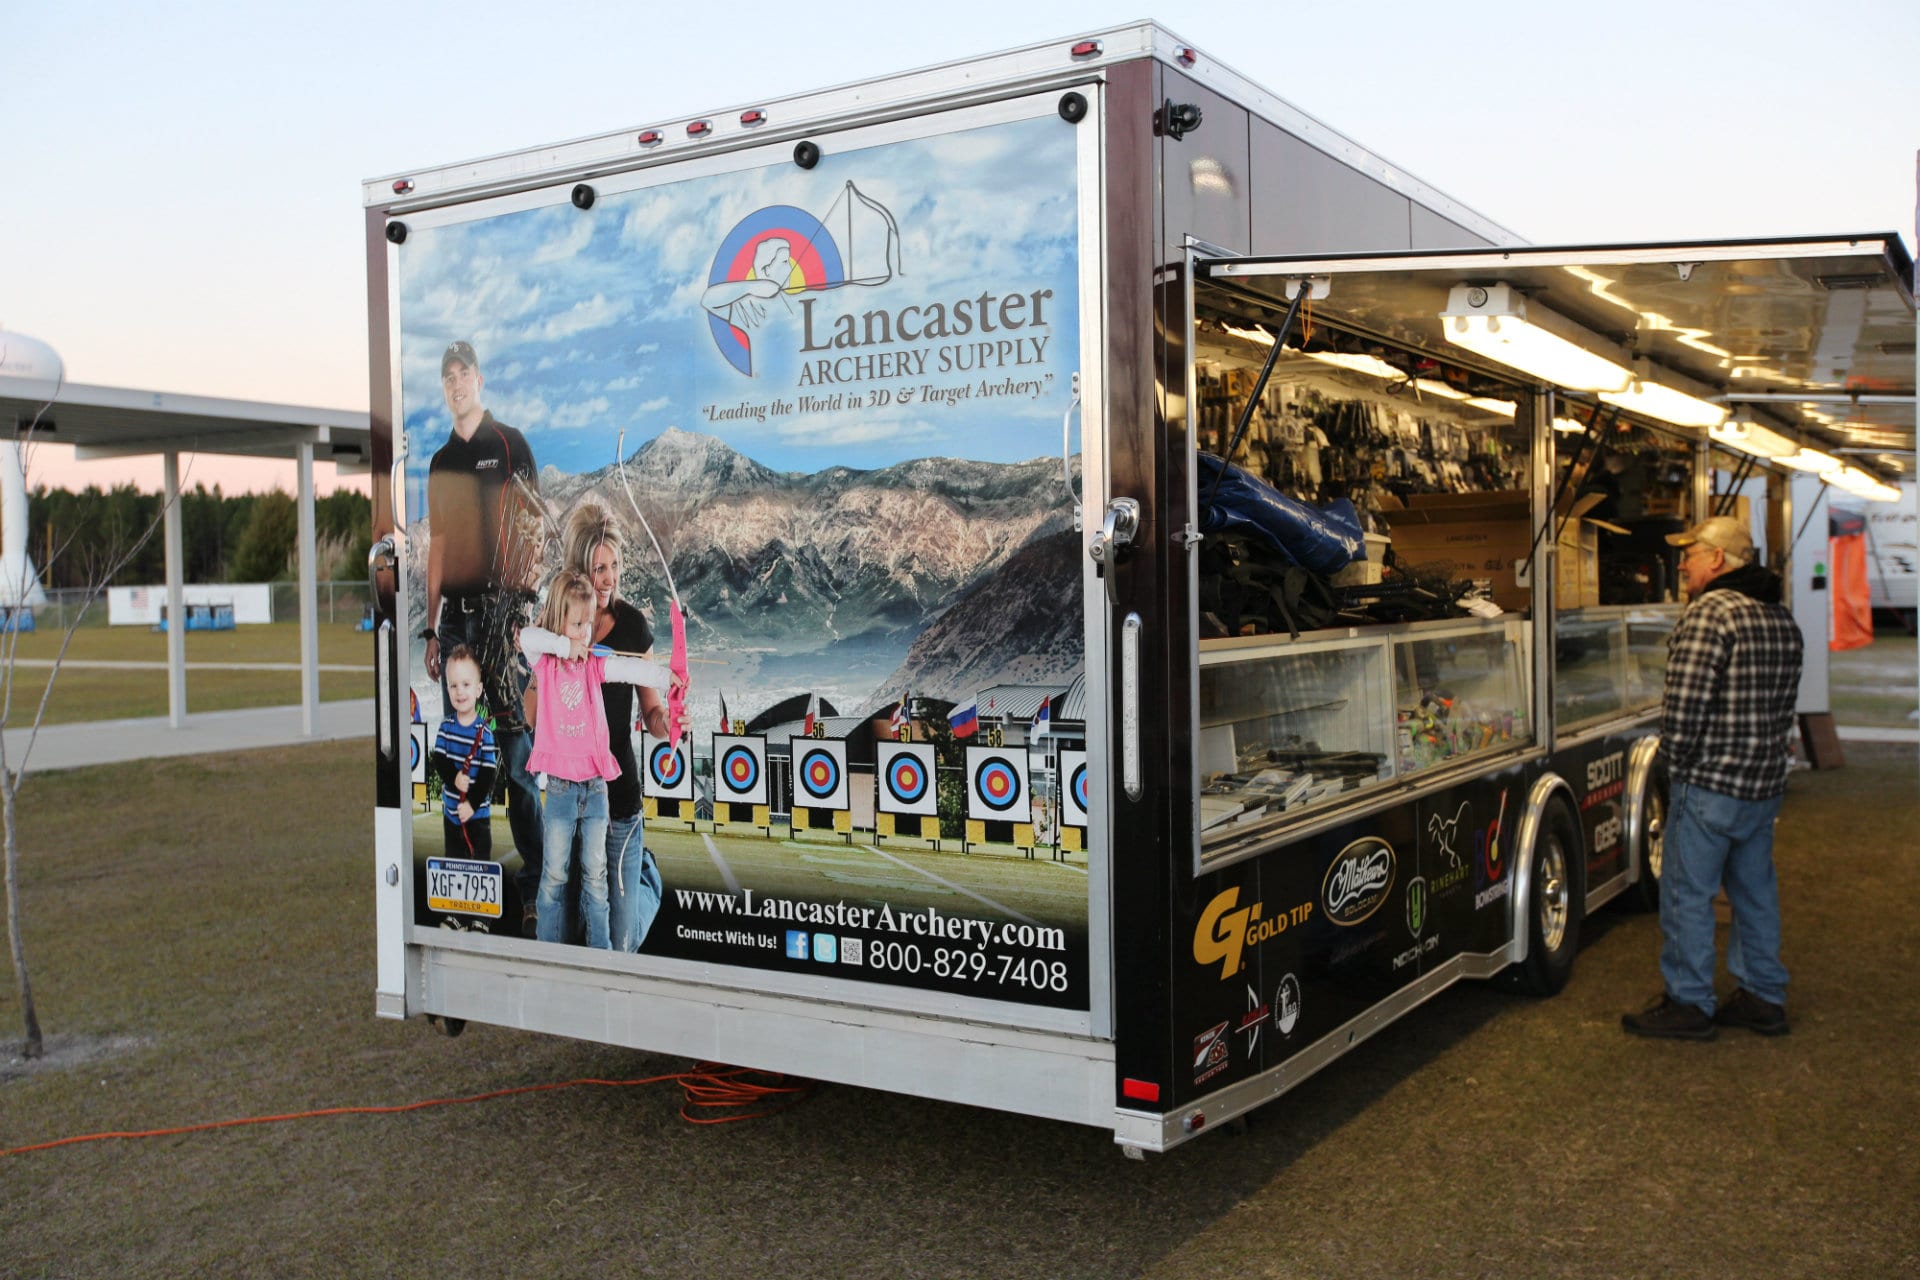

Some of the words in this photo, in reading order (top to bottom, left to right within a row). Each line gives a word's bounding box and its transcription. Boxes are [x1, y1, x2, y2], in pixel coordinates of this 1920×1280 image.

[798, 286, 1054, 354] Lancaster
[797, 348, 931, 387] ARCHERY
[938, 335, 1051, 374] SUPPLY
[771, 399, 793, 416] the
[798, 393, 843, 413] World
[847, 392, 863, 409] in
[866, 389, 891, 407] 3D
[896, 387, 916, 404] &
[920, 383, 971, 407] Target
[734, 720, 745, 736] 55
[812, 722, 825, 738] 56
[900, 727, 911, 742] 57
[988, 728, 1003, 747] 58
[1587, 751, 1624, 791] SCOTT
[445, 863, 484, 873] PENNSYLVANIA
[1430, 864, 1471, 895] RINEHART
[449, 901, 482, 911] TRAILER
[674, 888, 1067, 952] www.LancasterArchery.com
[676, 924, 724, 944] Connect
[725, 930, 756, 947] With
[757, 933, 778, 950] Us!
[1246, 913, 1288, 946] GOLD
[1290, 902, 1313, 927] TIP
[869, 940, 1069, 993] 800-829-7408
